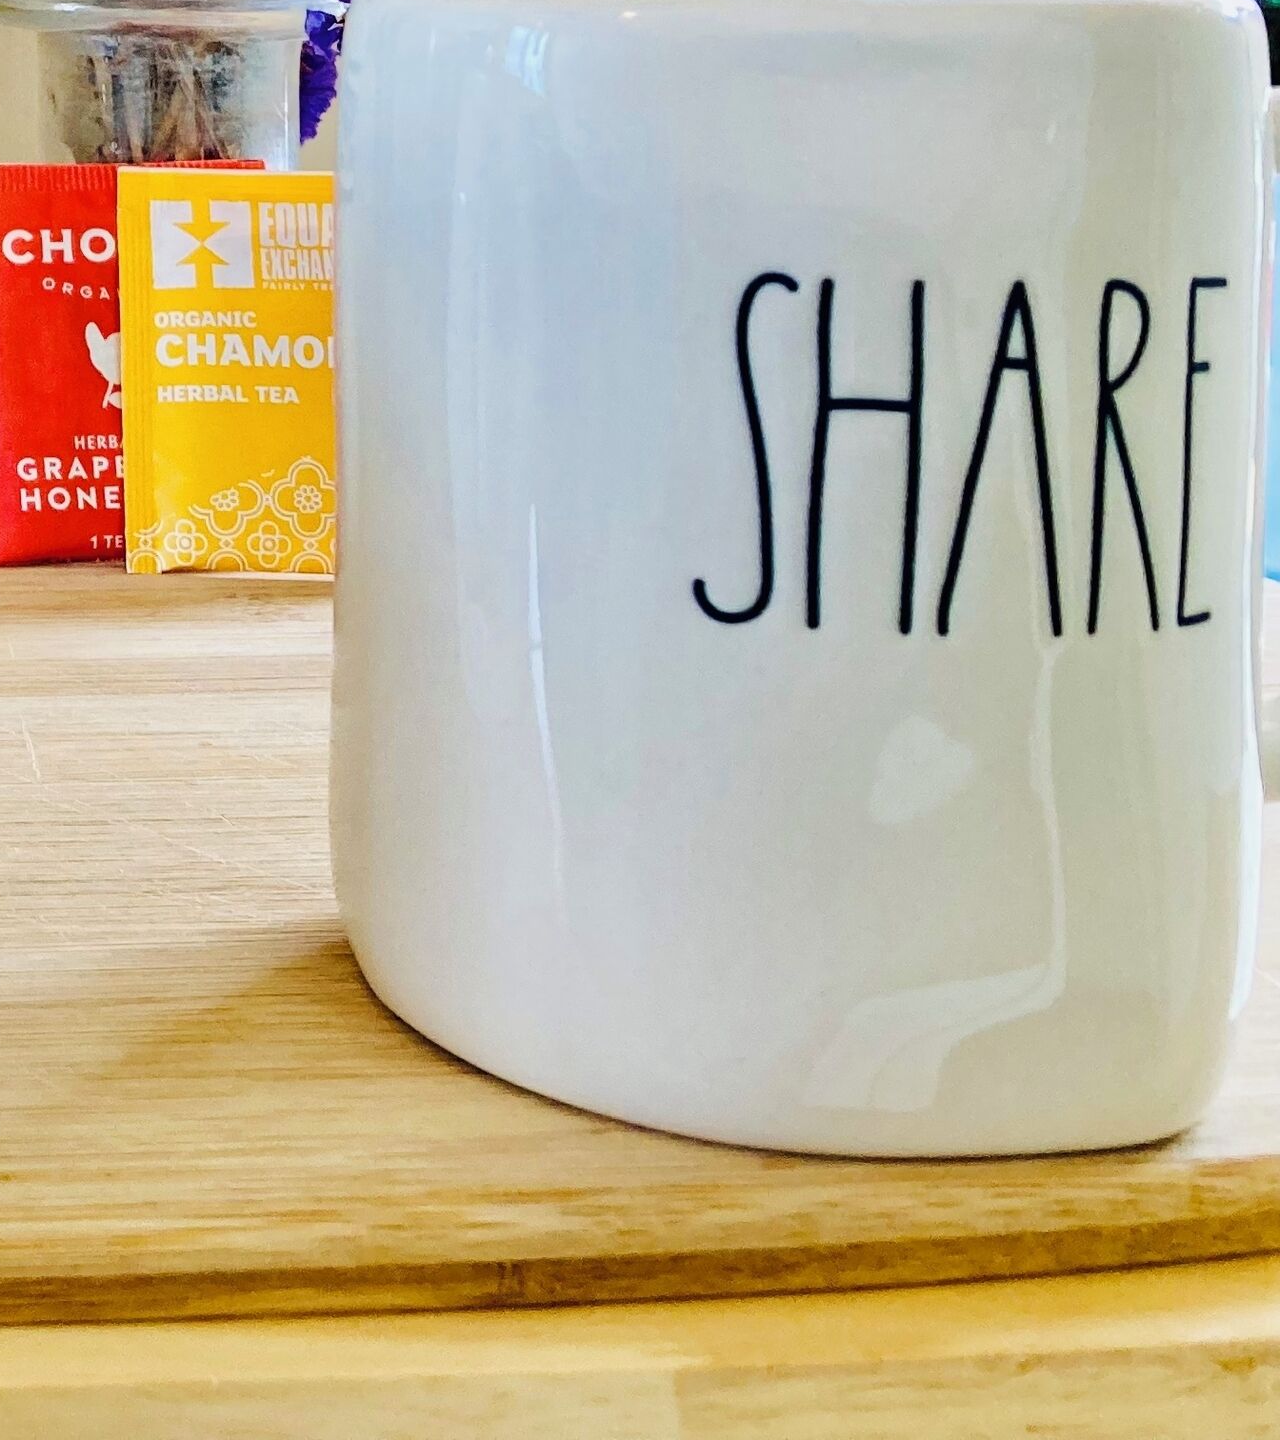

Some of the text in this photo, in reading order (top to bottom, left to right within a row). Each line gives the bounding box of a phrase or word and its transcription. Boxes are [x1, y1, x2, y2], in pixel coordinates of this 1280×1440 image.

[2, 228, 116, 265] CHO
[42, 277, 120, 300] ORGA
[154, 311, 257, 328] ORGANIC
[157, 385, 300, 404] HERBAL TEA
[74, 434, 123, 450] HERB
[693, 272, 1227, 637] SHARE
[20, 486, 121, 512] HONE
